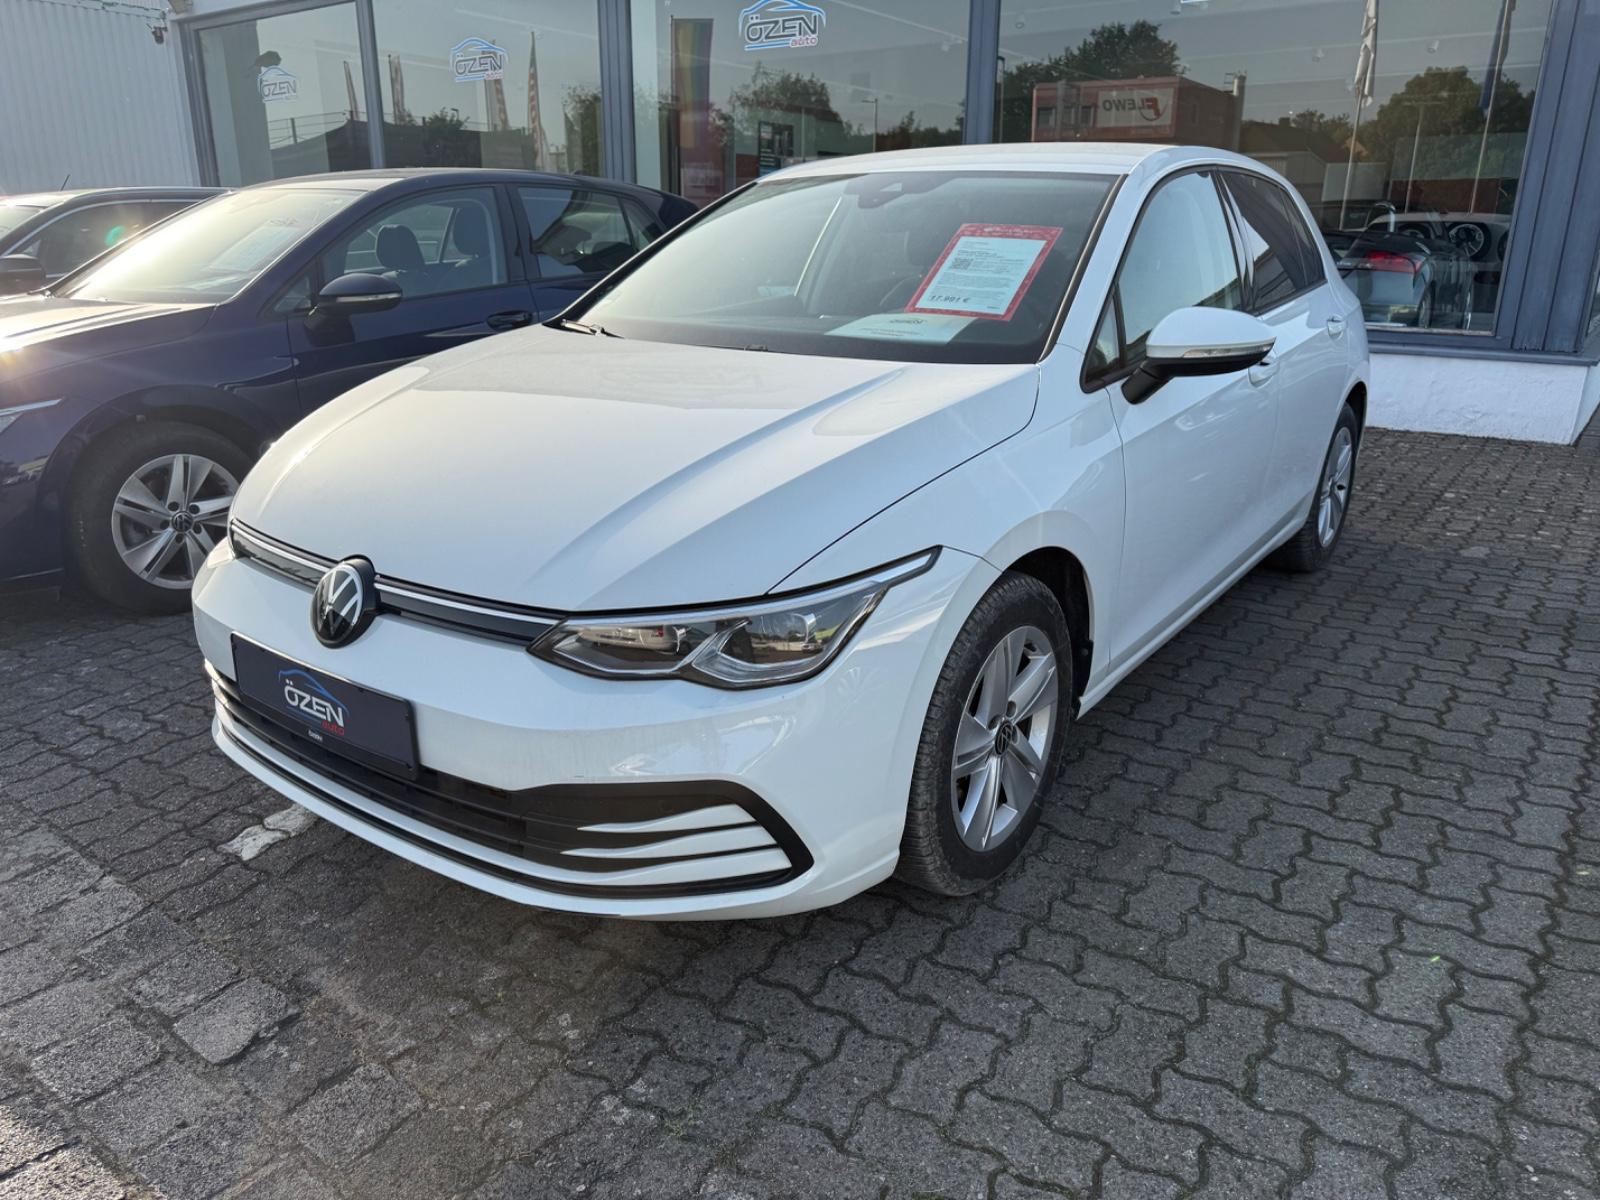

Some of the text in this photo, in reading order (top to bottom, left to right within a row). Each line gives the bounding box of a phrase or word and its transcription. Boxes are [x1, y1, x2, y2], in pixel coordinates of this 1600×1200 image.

[746, 15, 817, 42] ÖZEN
[791, 36, 817, 47] auto
[455, 53, 502, 75] ÖZEN
[284, 679, 345, 728] ÖZEN
[322, 719, 345, 736] auto
